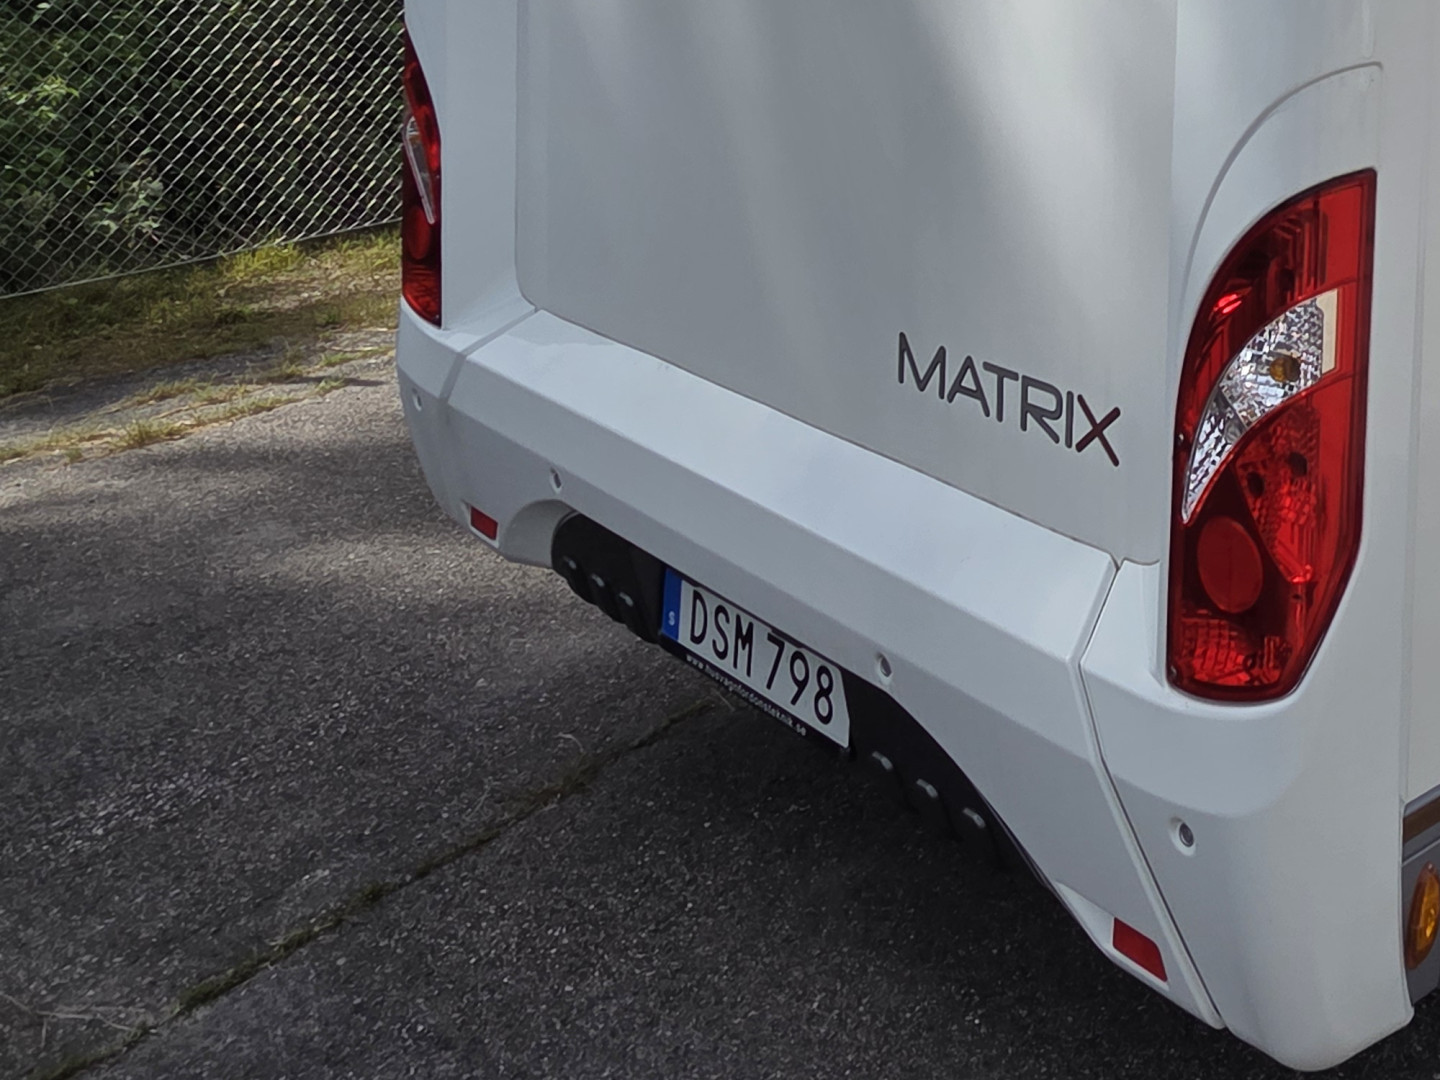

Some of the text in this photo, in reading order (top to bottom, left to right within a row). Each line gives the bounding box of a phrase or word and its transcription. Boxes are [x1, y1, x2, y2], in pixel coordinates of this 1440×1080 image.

[898, 331, 1121, 467] MATRIX
[668, 611, 675, 626] S
[690, 589, 834, 725] DSM 798
